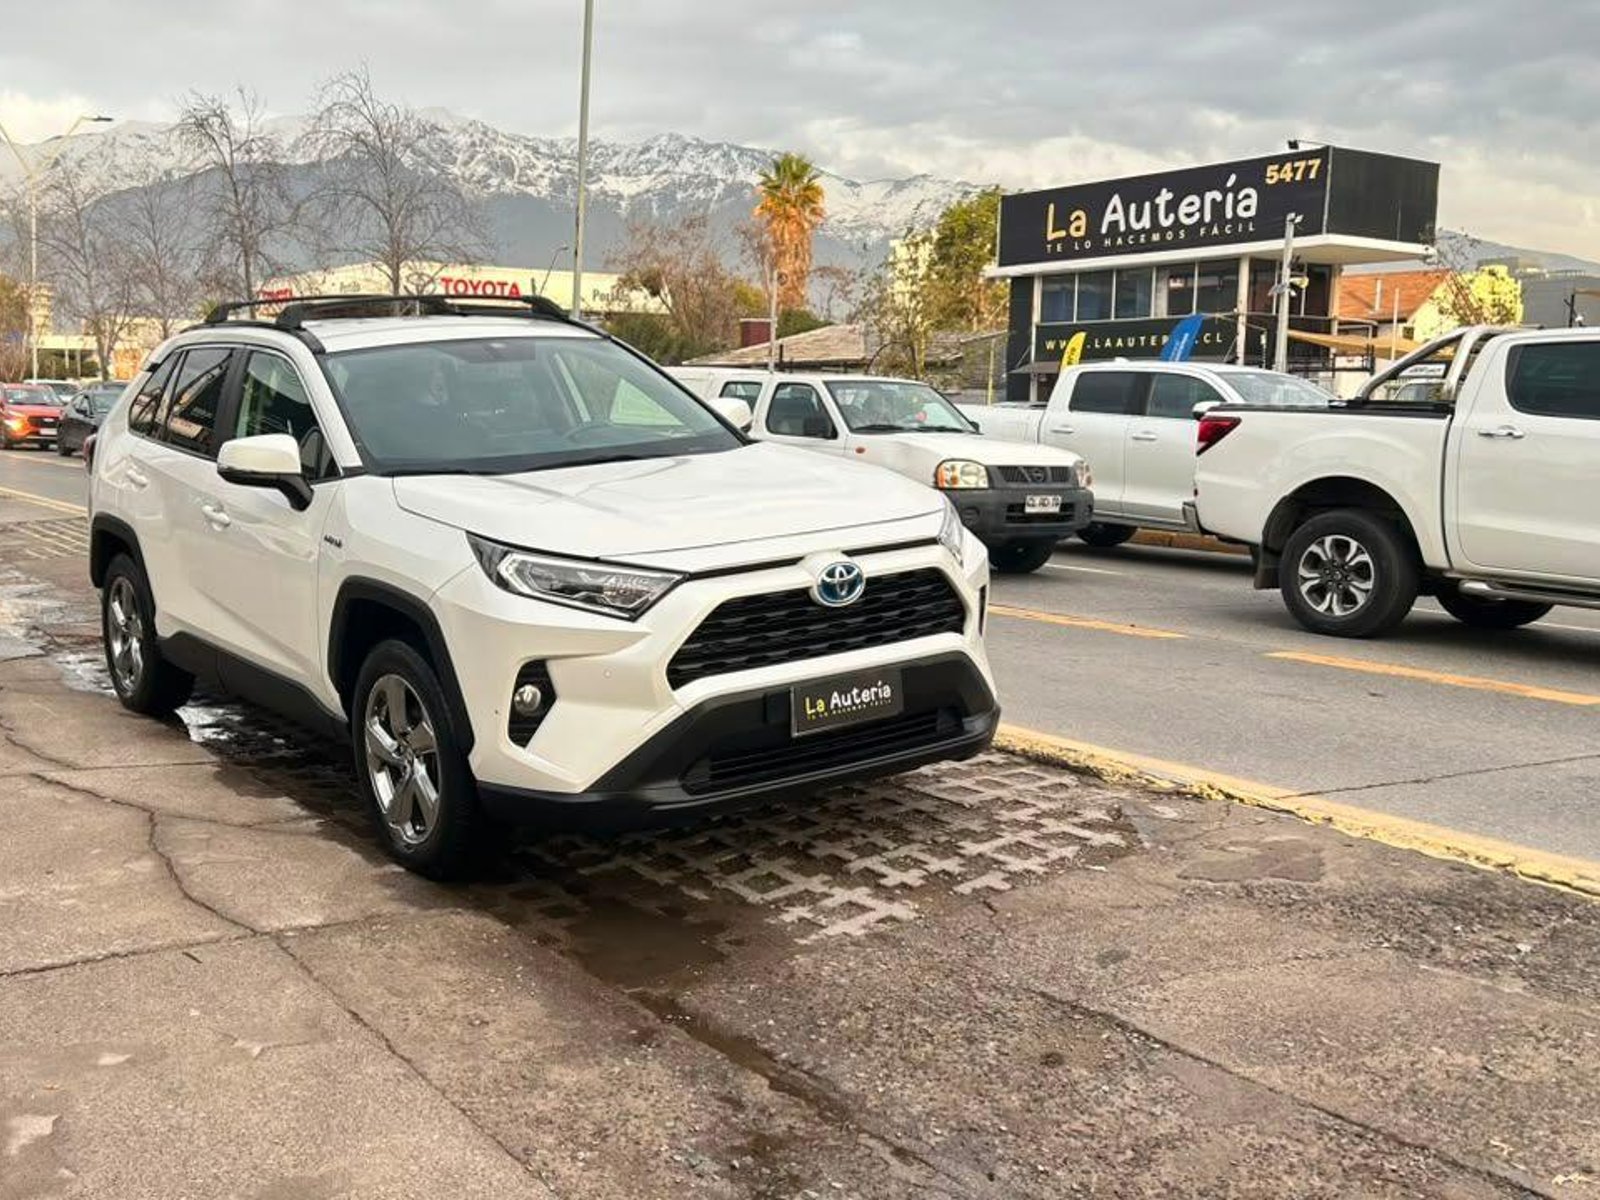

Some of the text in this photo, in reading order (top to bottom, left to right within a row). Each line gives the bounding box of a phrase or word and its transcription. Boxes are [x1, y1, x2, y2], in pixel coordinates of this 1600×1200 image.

[1265, 158, 1321, 184] 5477
[1046, 173, 1258, 240] La Autería
[1046, 244, 1063, 253] TE
[1074, 240, 1092, 250] LO
[1104, 230, 1186, 247] HACEMOS
[441, 277, 520, 297] TOYOTA
[805, 697, 826, 714] La
[830, 680, 892, 709] Autería
